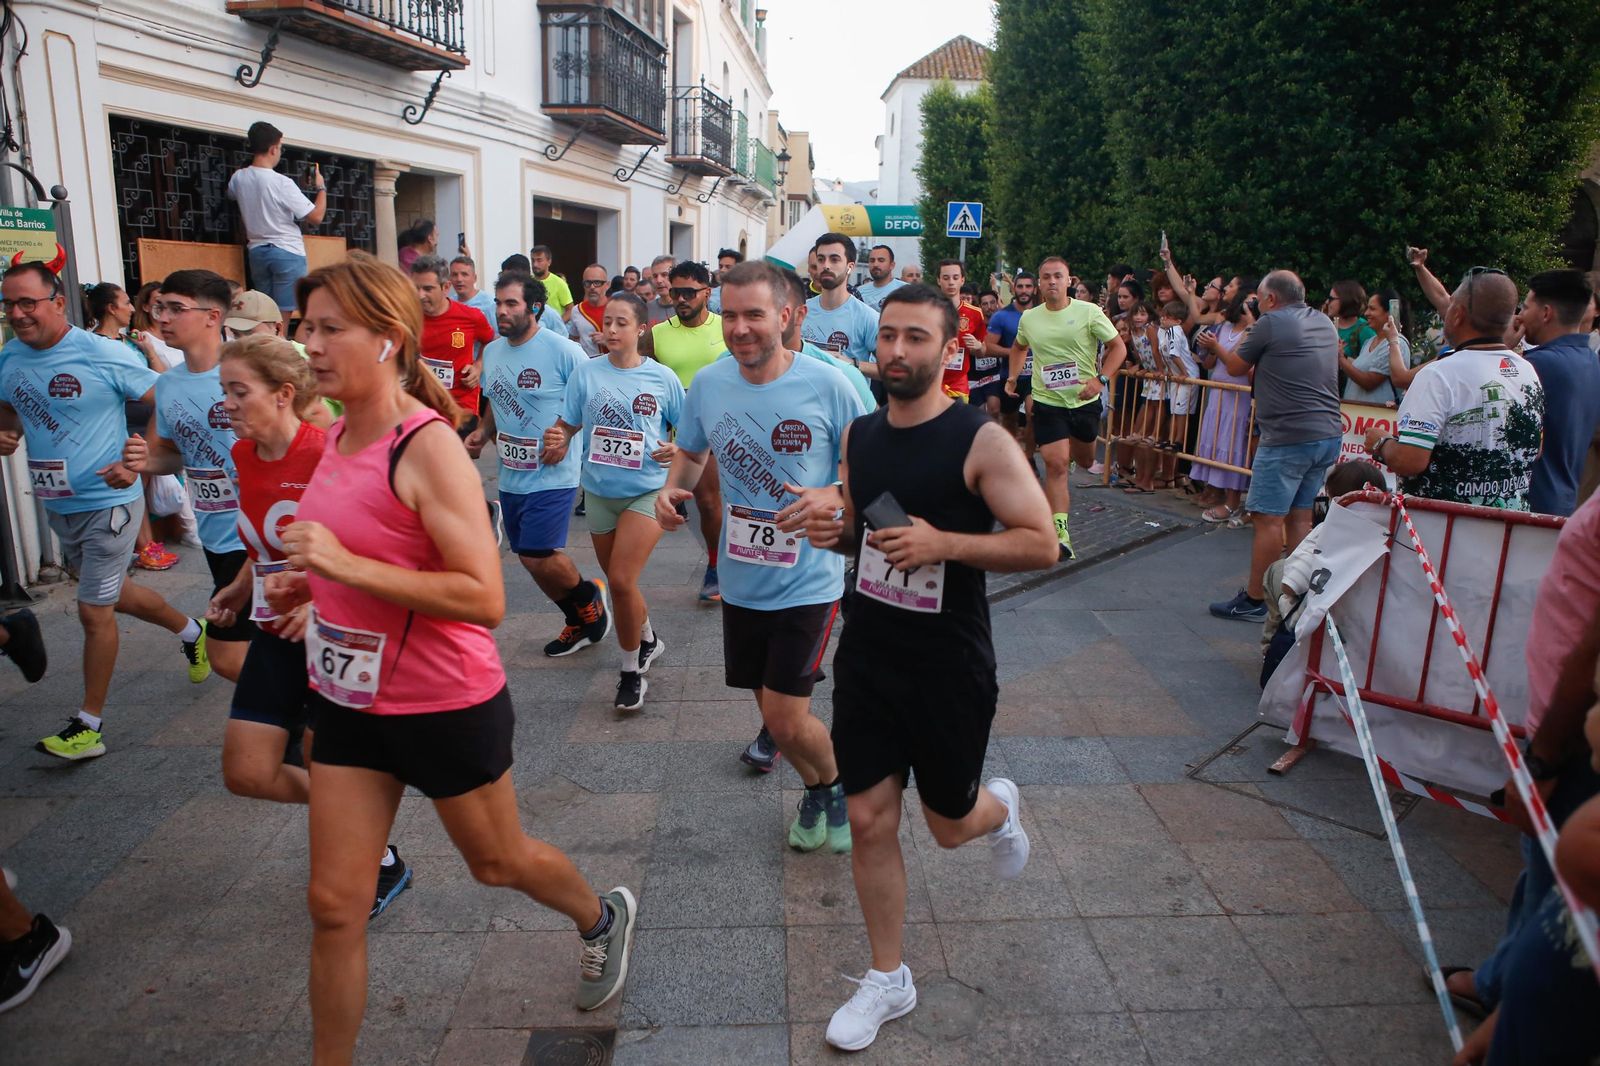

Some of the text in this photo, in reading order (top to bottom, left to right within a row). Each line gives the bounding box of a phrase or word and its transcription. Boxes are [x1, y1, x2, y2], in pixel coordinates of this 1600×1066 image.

[0, 218, 46, 230] Los Barrios
[15, 210, 23, 218] de
[1050, 369, 1072, 381] 236
[13, 386, 59, 434] NOCTURNA
[490, 380, 525, 420] NOCTURNA
[174, 420, 226, 468] NOCTURNA
[504, 444, 528, 461] 303
[602, 439, 632, 456] 373
[734, 425, 776, 470] VI CARRERA
[719, 453, 761, 497] SOLIDARIA
[723, 438, 787, 503] NOCTURNA
[1456, 481, 1499, 496] CAMPO
[748, 523, 775, 546] 78
[321, 646, 355, 680] 67
